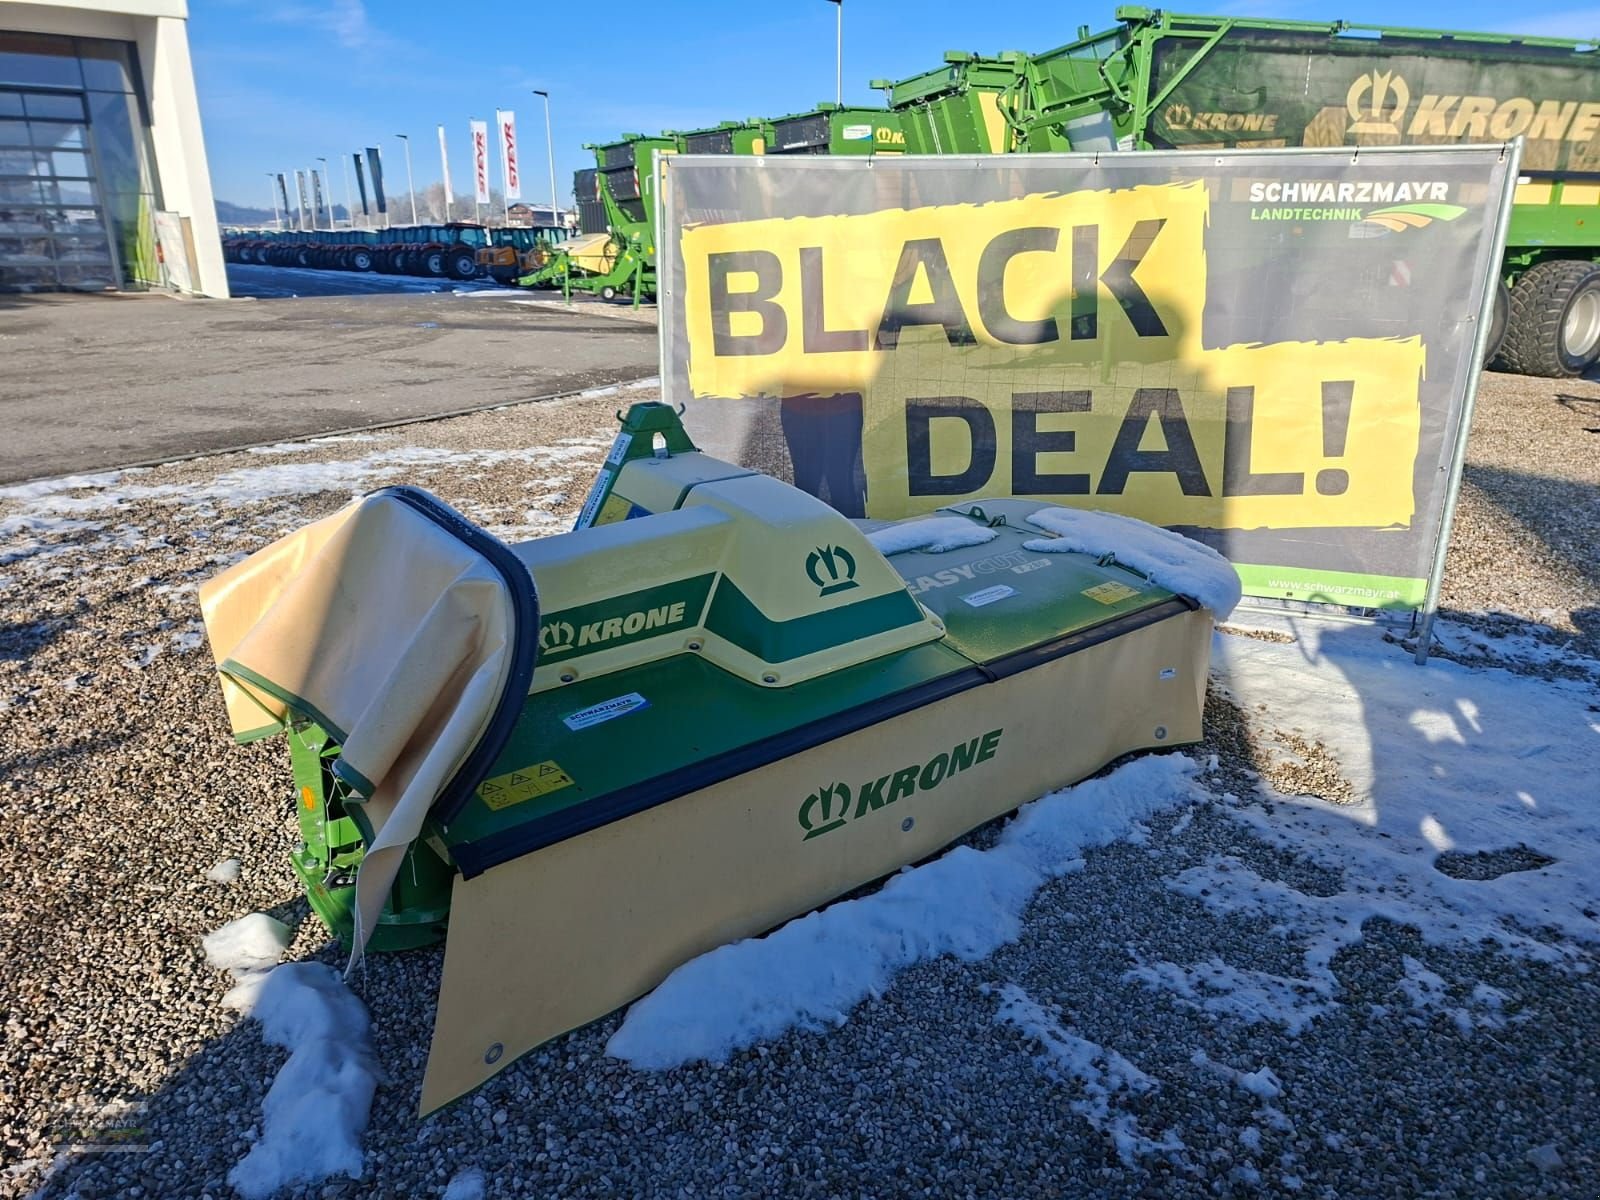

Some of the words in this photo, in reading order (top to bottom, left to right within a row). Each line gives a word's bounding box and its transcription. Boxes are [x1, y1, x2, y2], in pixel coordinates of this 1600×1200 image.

[1192, 113, 1278, 132] KRONE
[1407, 95, 1600, 141] KRONE
[475, 132, 486, 194] STEYR
[504, 122, 517, 189] STEYR
[1249, 182, 1449, 203] SCHWARZMAYR
[1251, 208, 1363, 220] LANDTECHNIK
[707, 218, 1168, 357] BLACK
[904, 380, 1355, 497] DEAL!
[1268, 579, 1400, 600] www.schwarzmayr.at
[578, 601, 686, 647] KRONE
[854, 728, 1003, 819] KRONE
